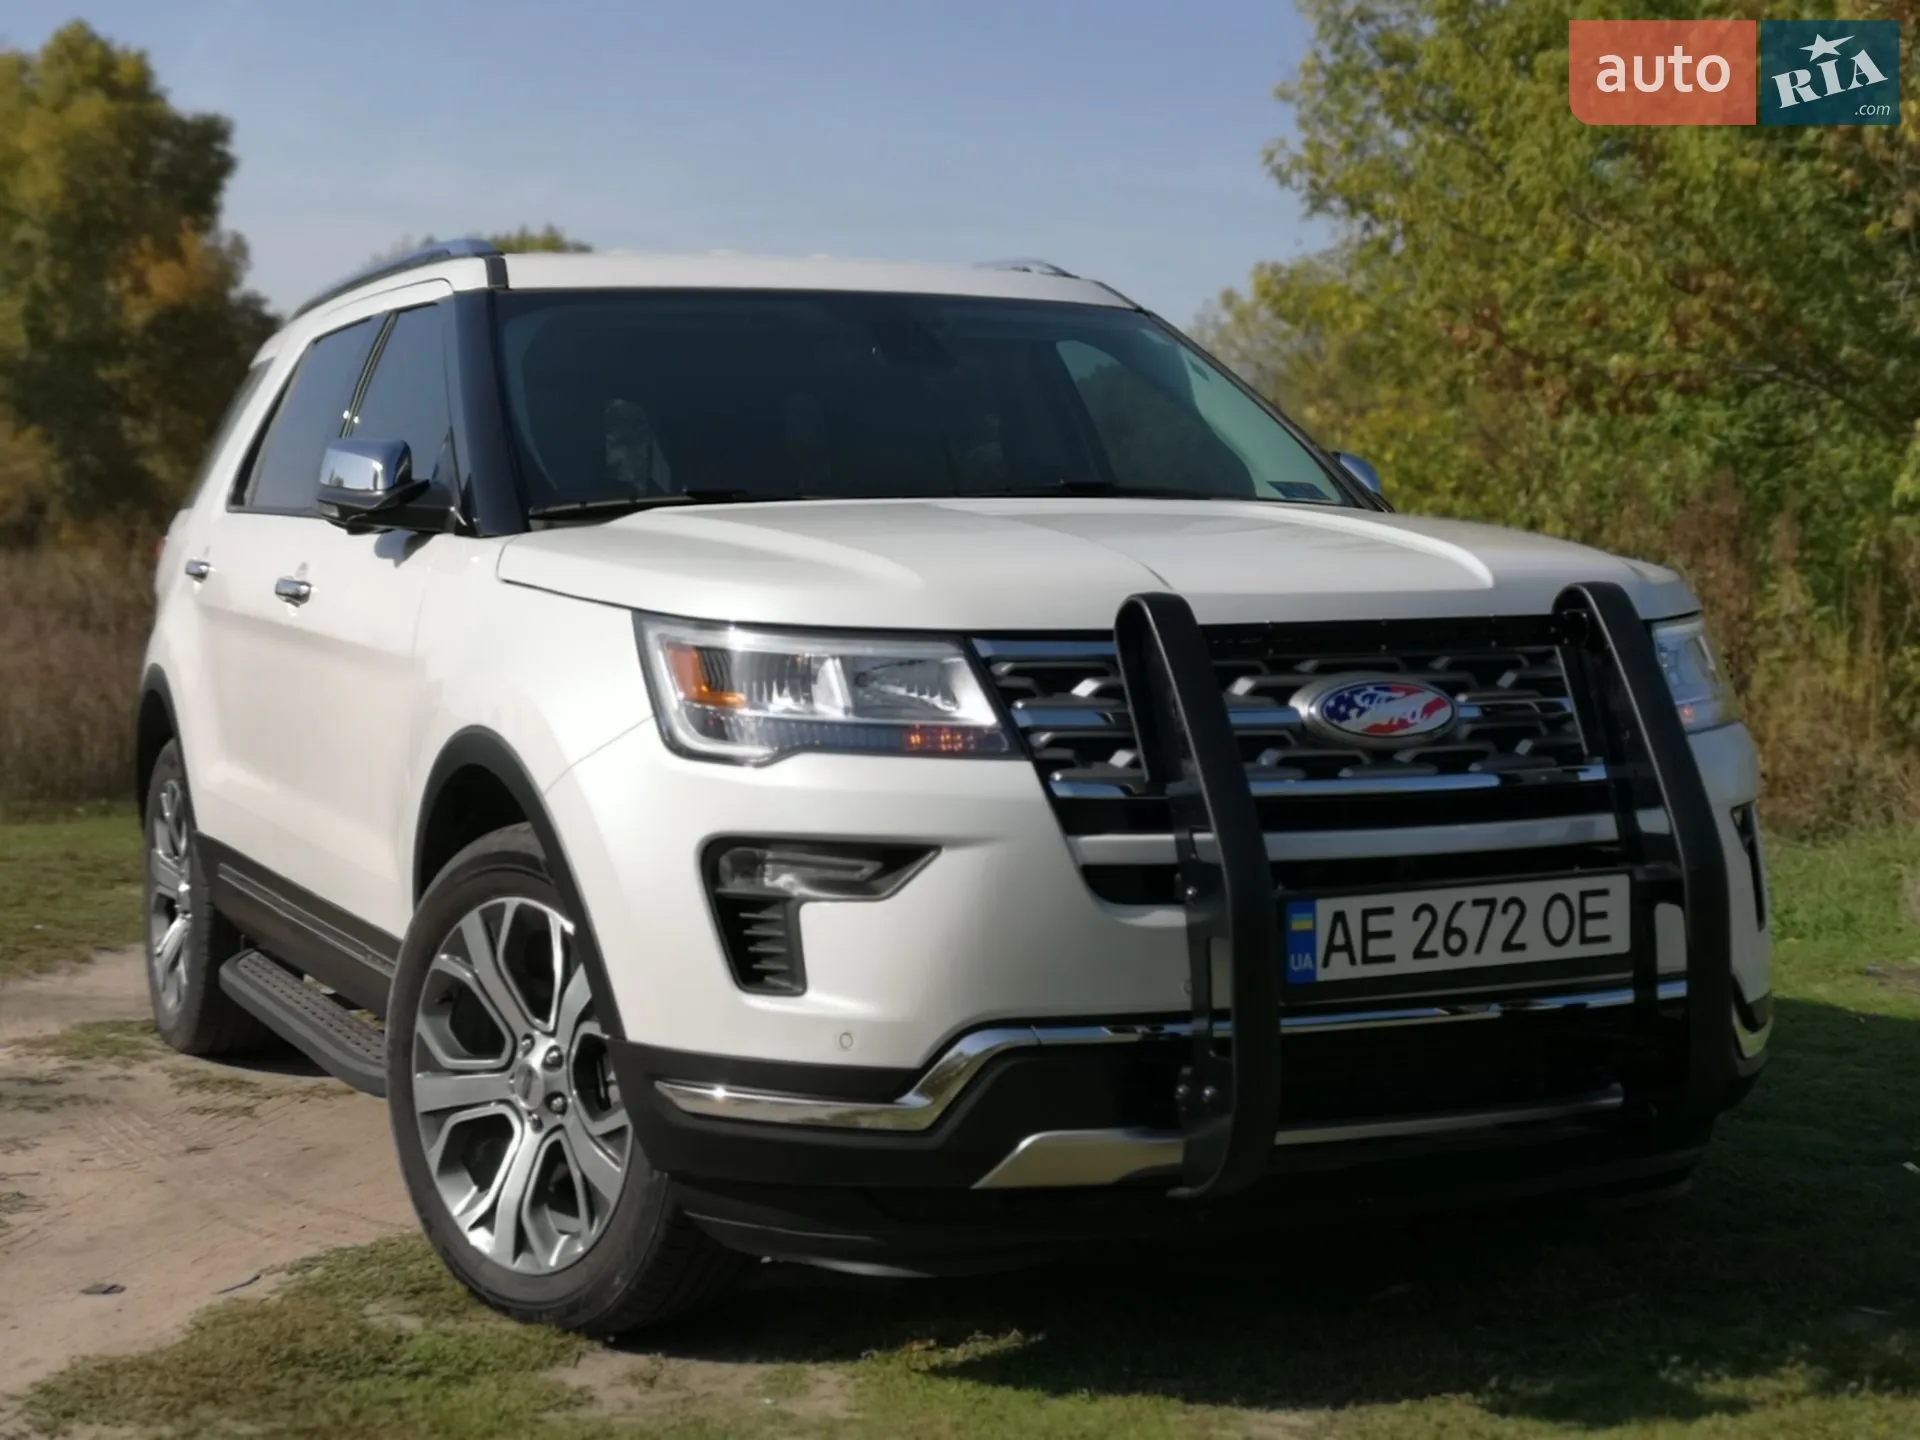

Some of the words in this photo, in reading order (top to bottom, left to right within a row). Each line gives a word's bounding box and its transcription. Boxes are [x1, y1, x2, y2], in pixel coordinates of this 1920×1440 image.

[1322, 906, 1396, 969] AE
[1411, 896, 1527, 960] 2672
[1542, 888, 1612, 948] OE
[1289, 953, 1313, 972] UA
